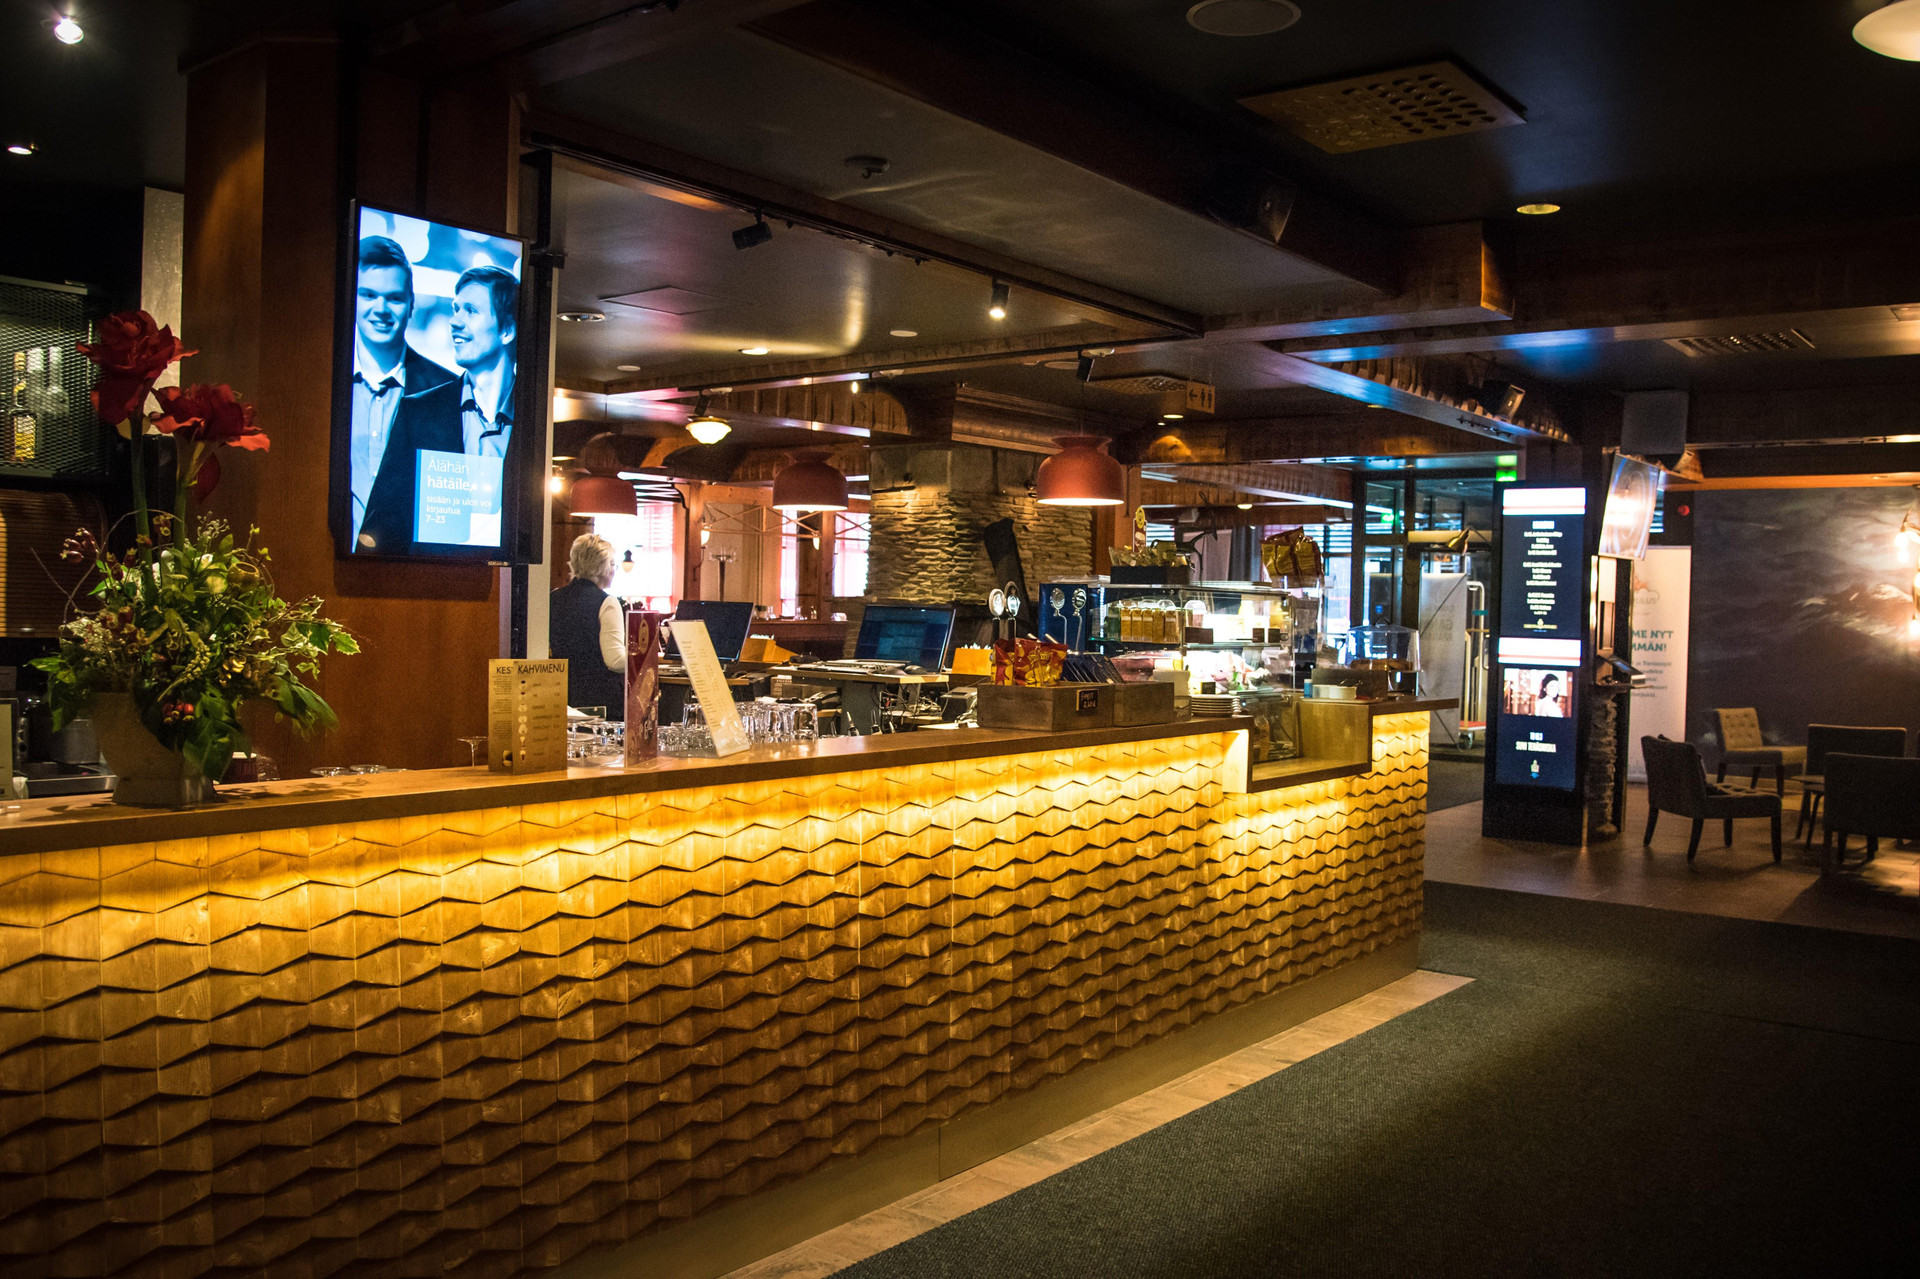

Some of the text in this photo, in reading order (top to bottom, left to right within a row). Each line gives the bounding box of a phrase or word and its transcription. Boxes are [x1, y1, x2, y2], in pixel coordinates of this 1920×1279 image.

[428, 456, 469, 473] Älähän
[426, 496, 451, 504] sisään
[453, 498, 460, 506] ja
[462, 498, 478, 506] ulos
[426, 504, 461, 515] kirjautua
[1651, 630, 1674, 639] NYT
[517, 663, 565, 675] KAHVIMENU
